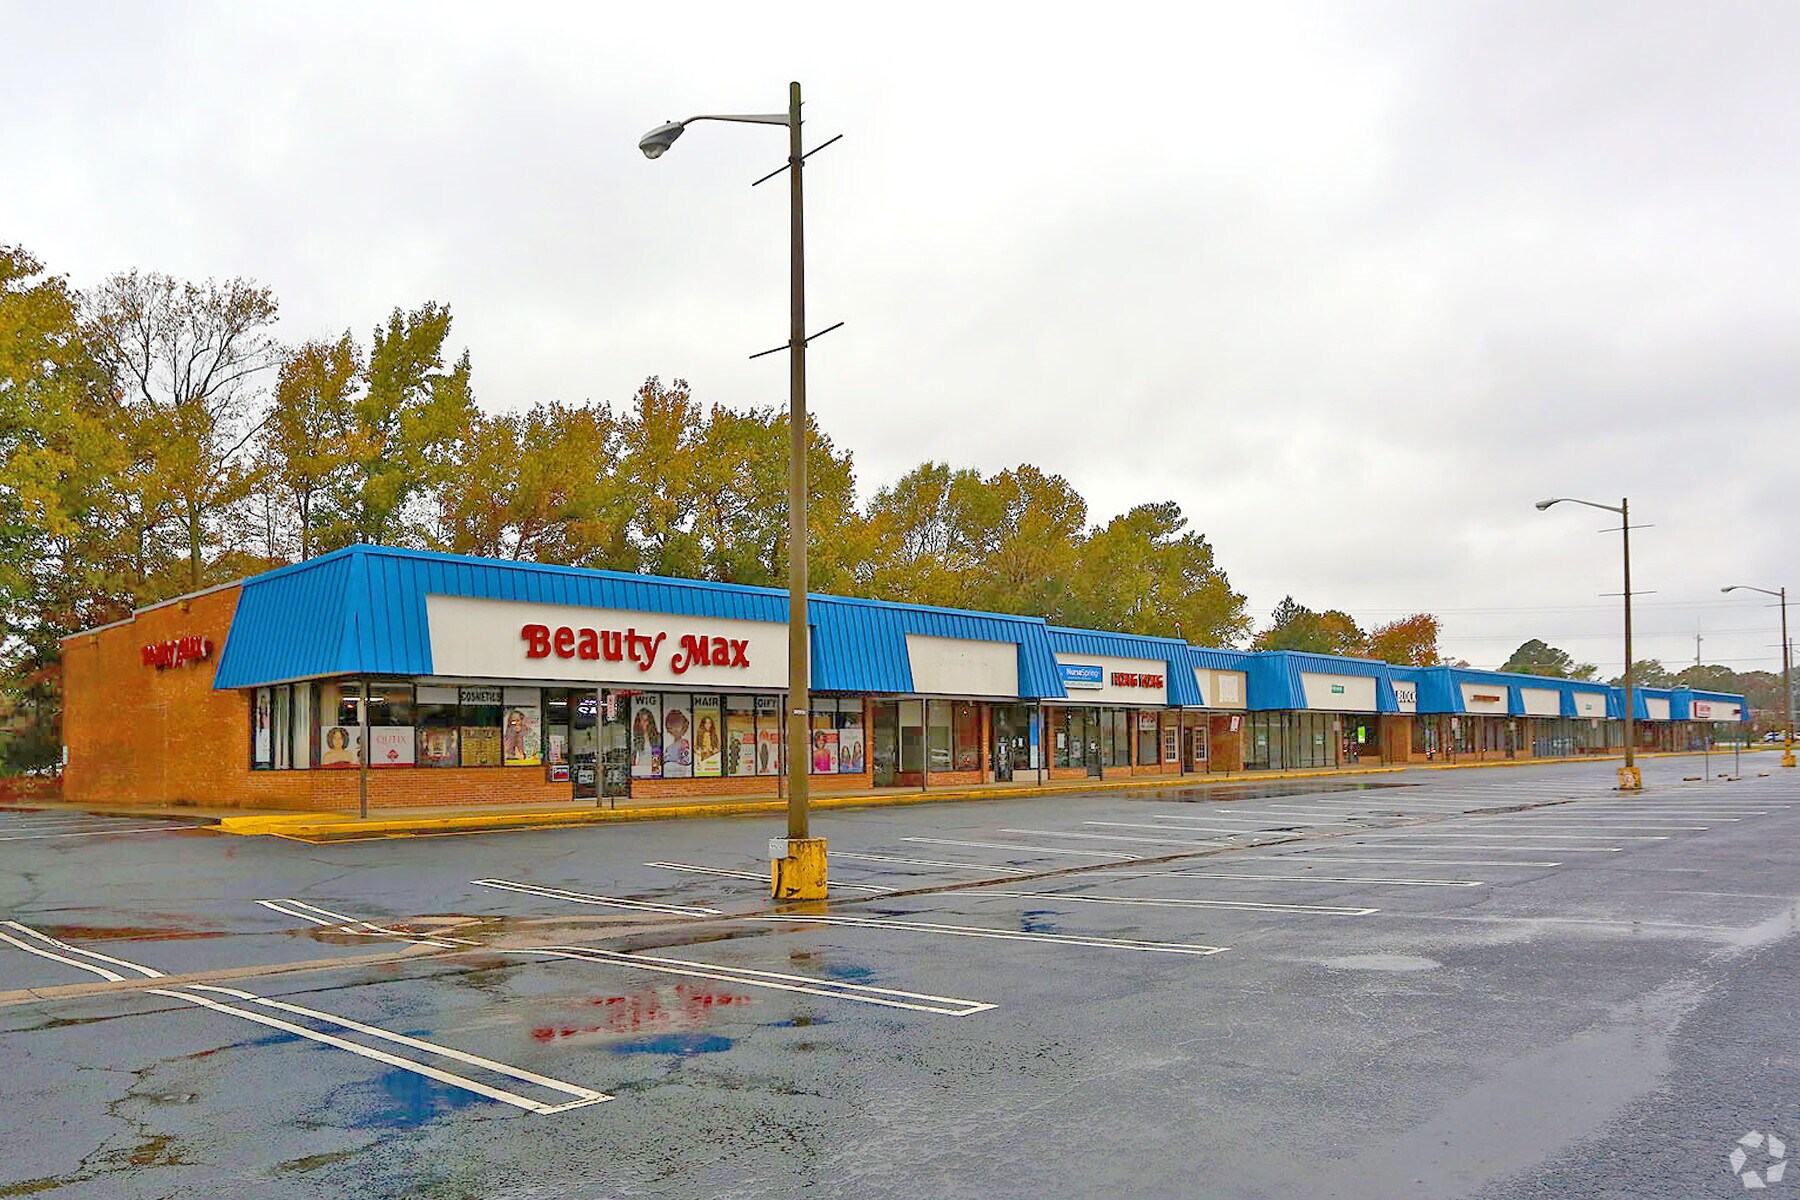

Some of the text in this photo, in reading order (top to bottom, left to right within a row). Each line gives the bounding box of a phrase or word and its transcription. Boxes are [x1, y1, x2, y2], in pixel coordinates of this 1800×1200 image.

[521, 624, 750, 675] Beauty Max
[1111, 672, 1164, 689] HONG KONG
[635, 695, 657, 706] WIG
[694, 697, 719, 707] HAIR
